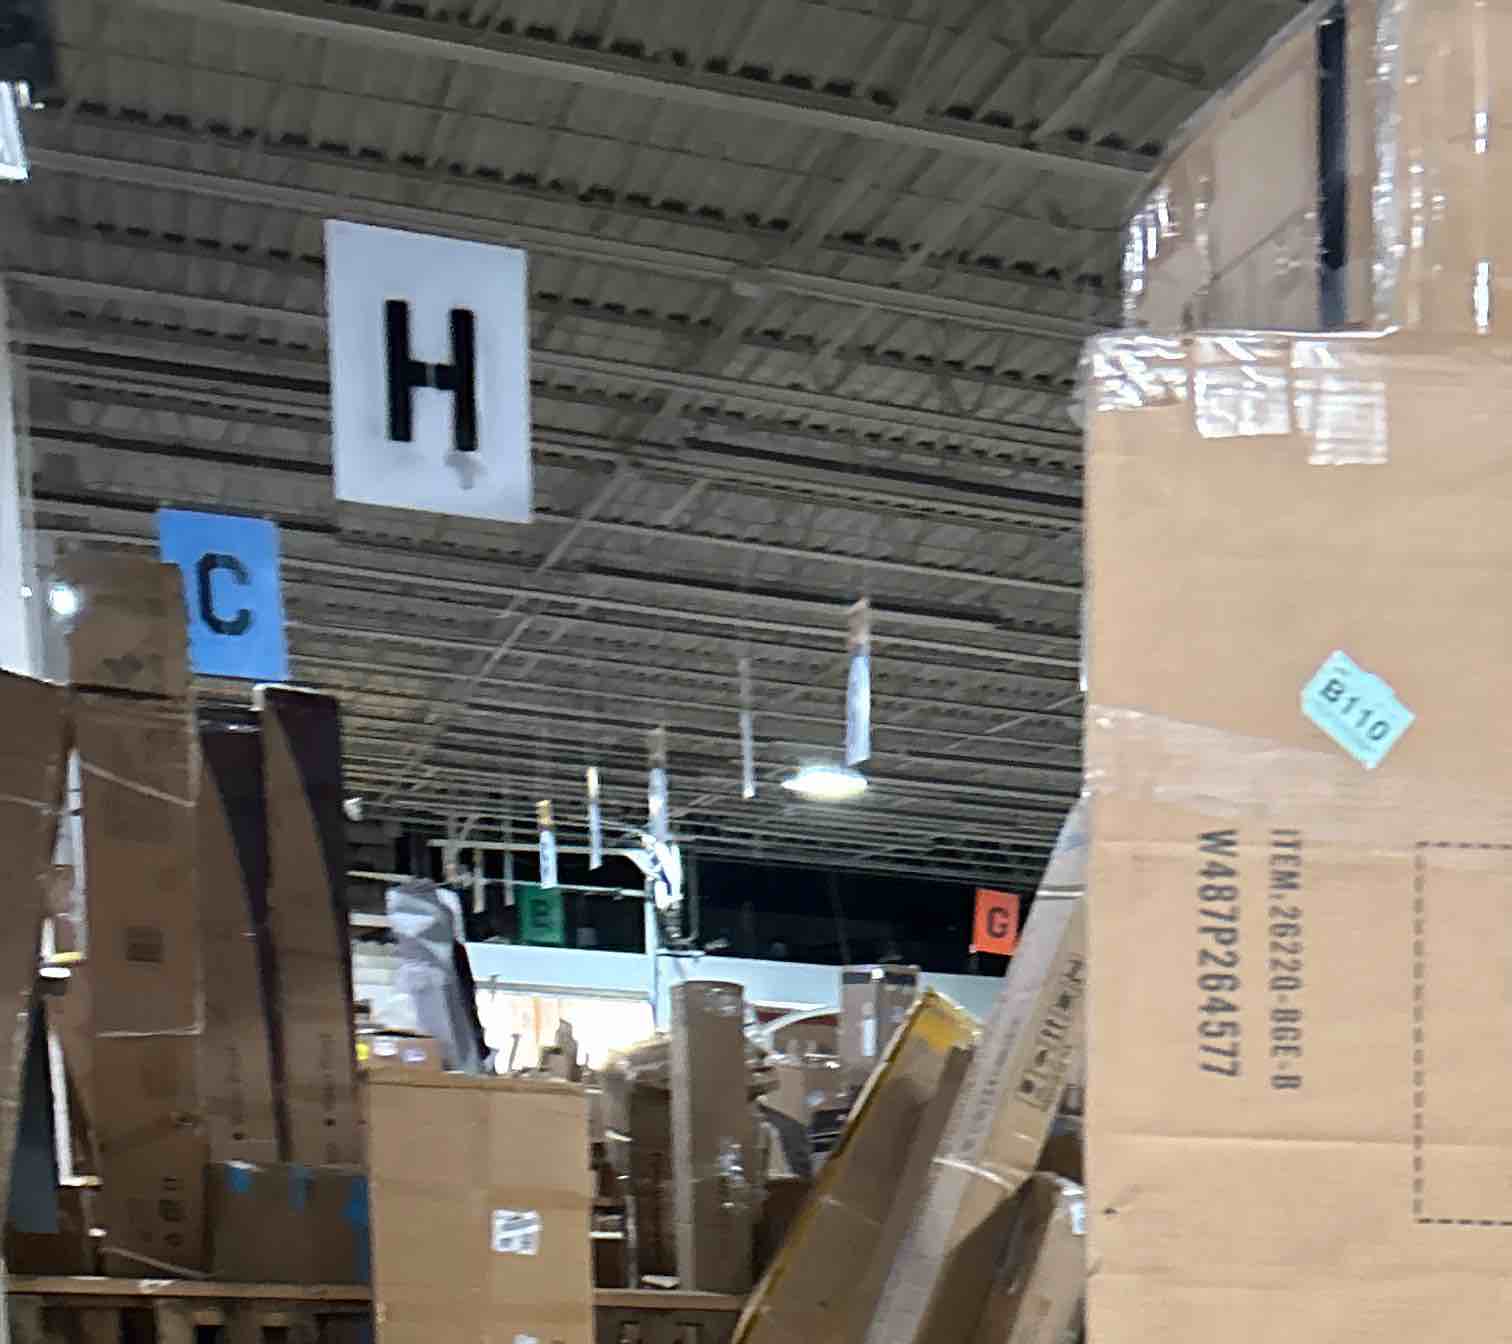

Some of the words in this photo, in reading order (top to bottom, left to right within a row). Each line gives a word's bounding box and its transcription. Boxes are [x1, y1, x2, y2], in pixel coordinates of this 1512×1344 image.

[384, 298, 478, 452] H
[199, 553, 252, 637] C
[1318, 677, 1391, 741] B110
[987, 906, 1010, 939] G
